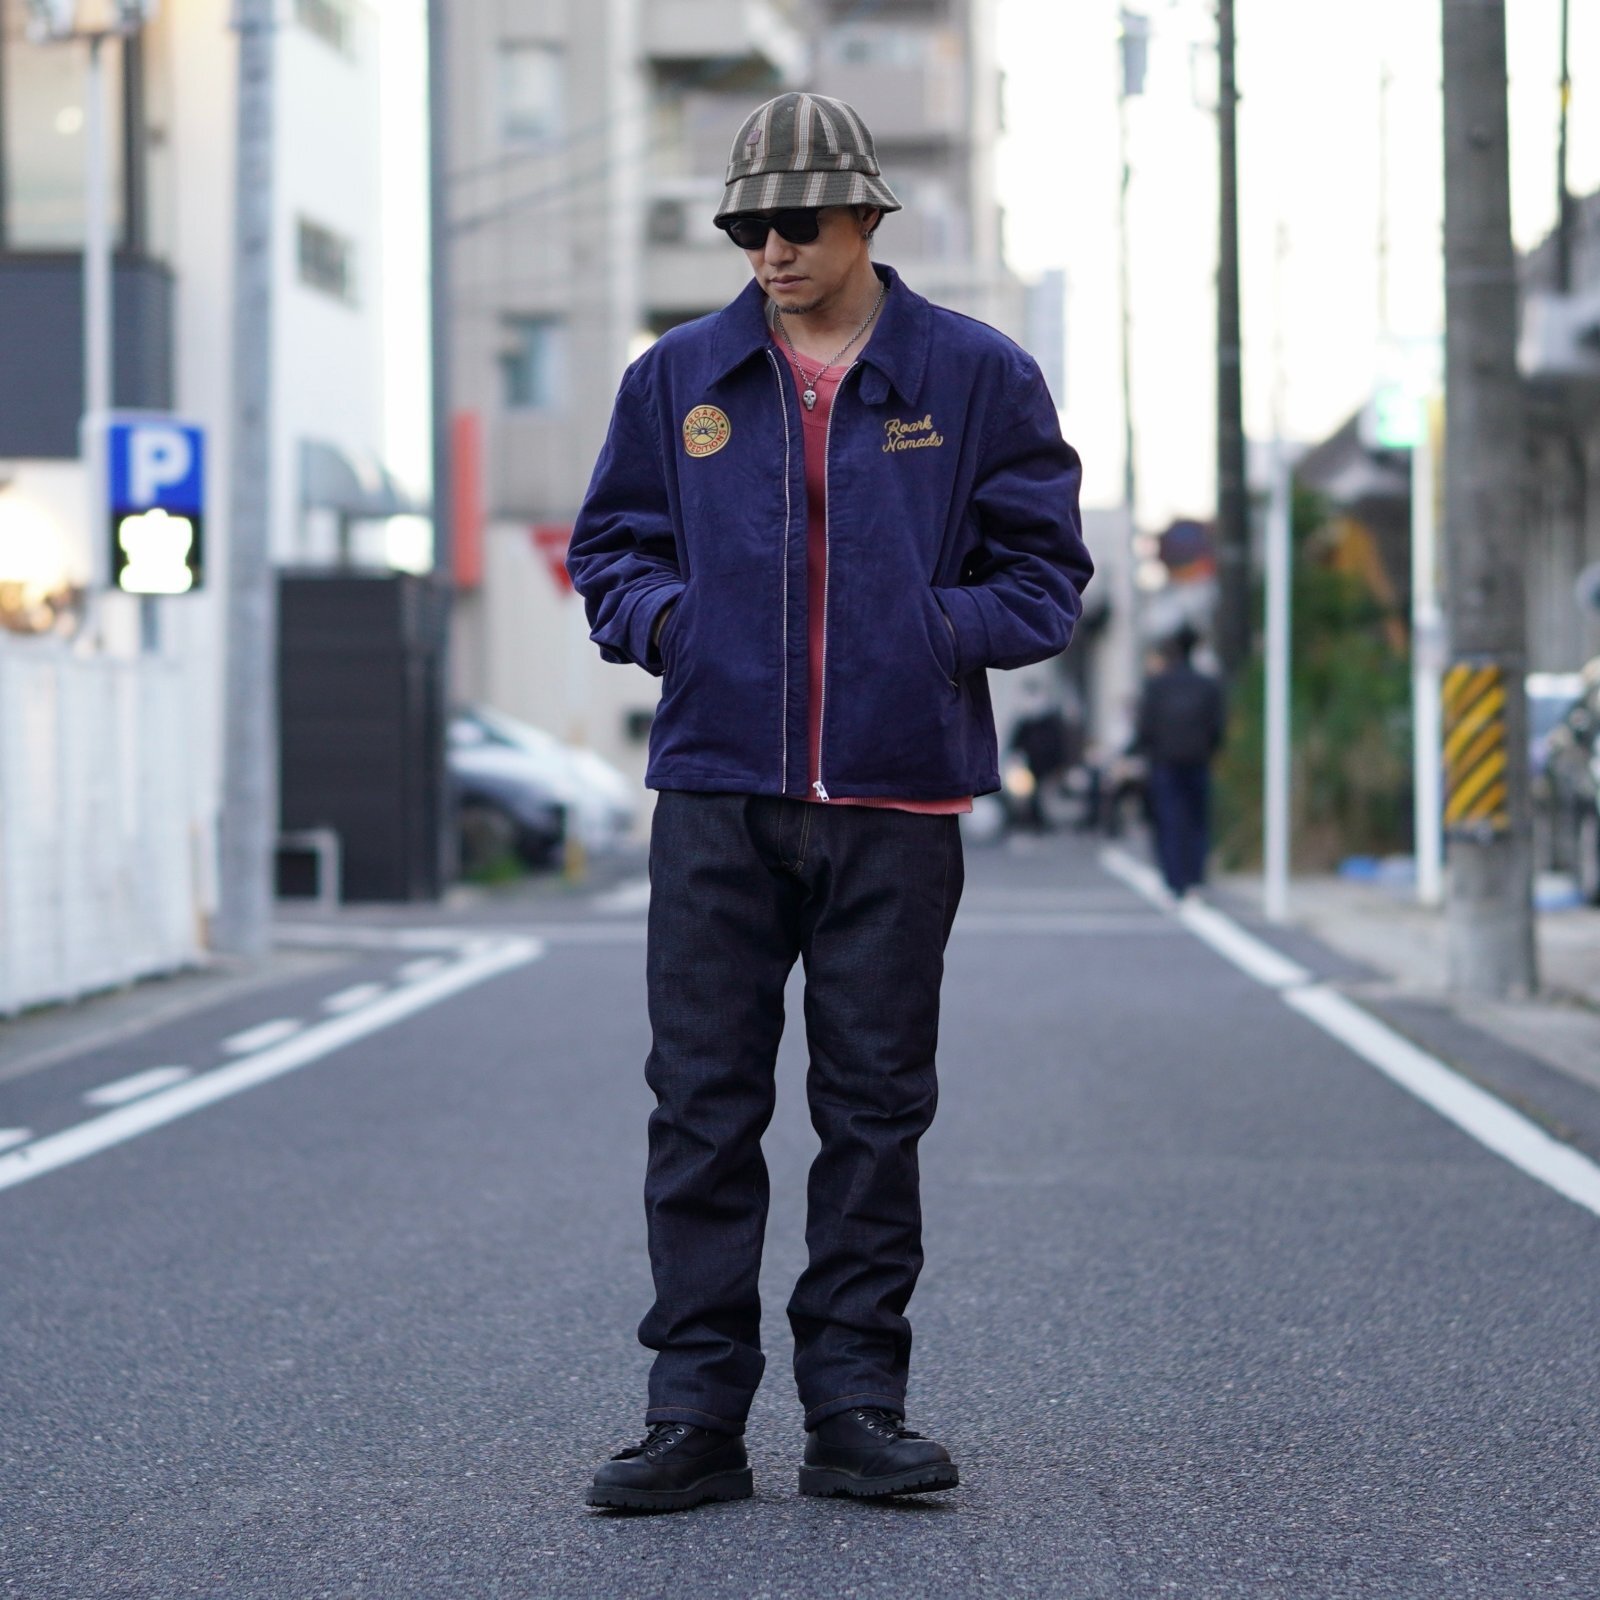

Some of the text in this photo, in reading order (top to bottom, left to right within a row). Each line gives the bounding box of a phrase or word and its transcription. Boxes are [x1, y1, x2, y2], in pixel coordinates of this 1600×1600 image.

[688, 409, 722, 425] ROARK
[884, 414, 933, 437] Roark
[882, 431, 944, 453] Nomads
[128, 425, 191, 505] P
